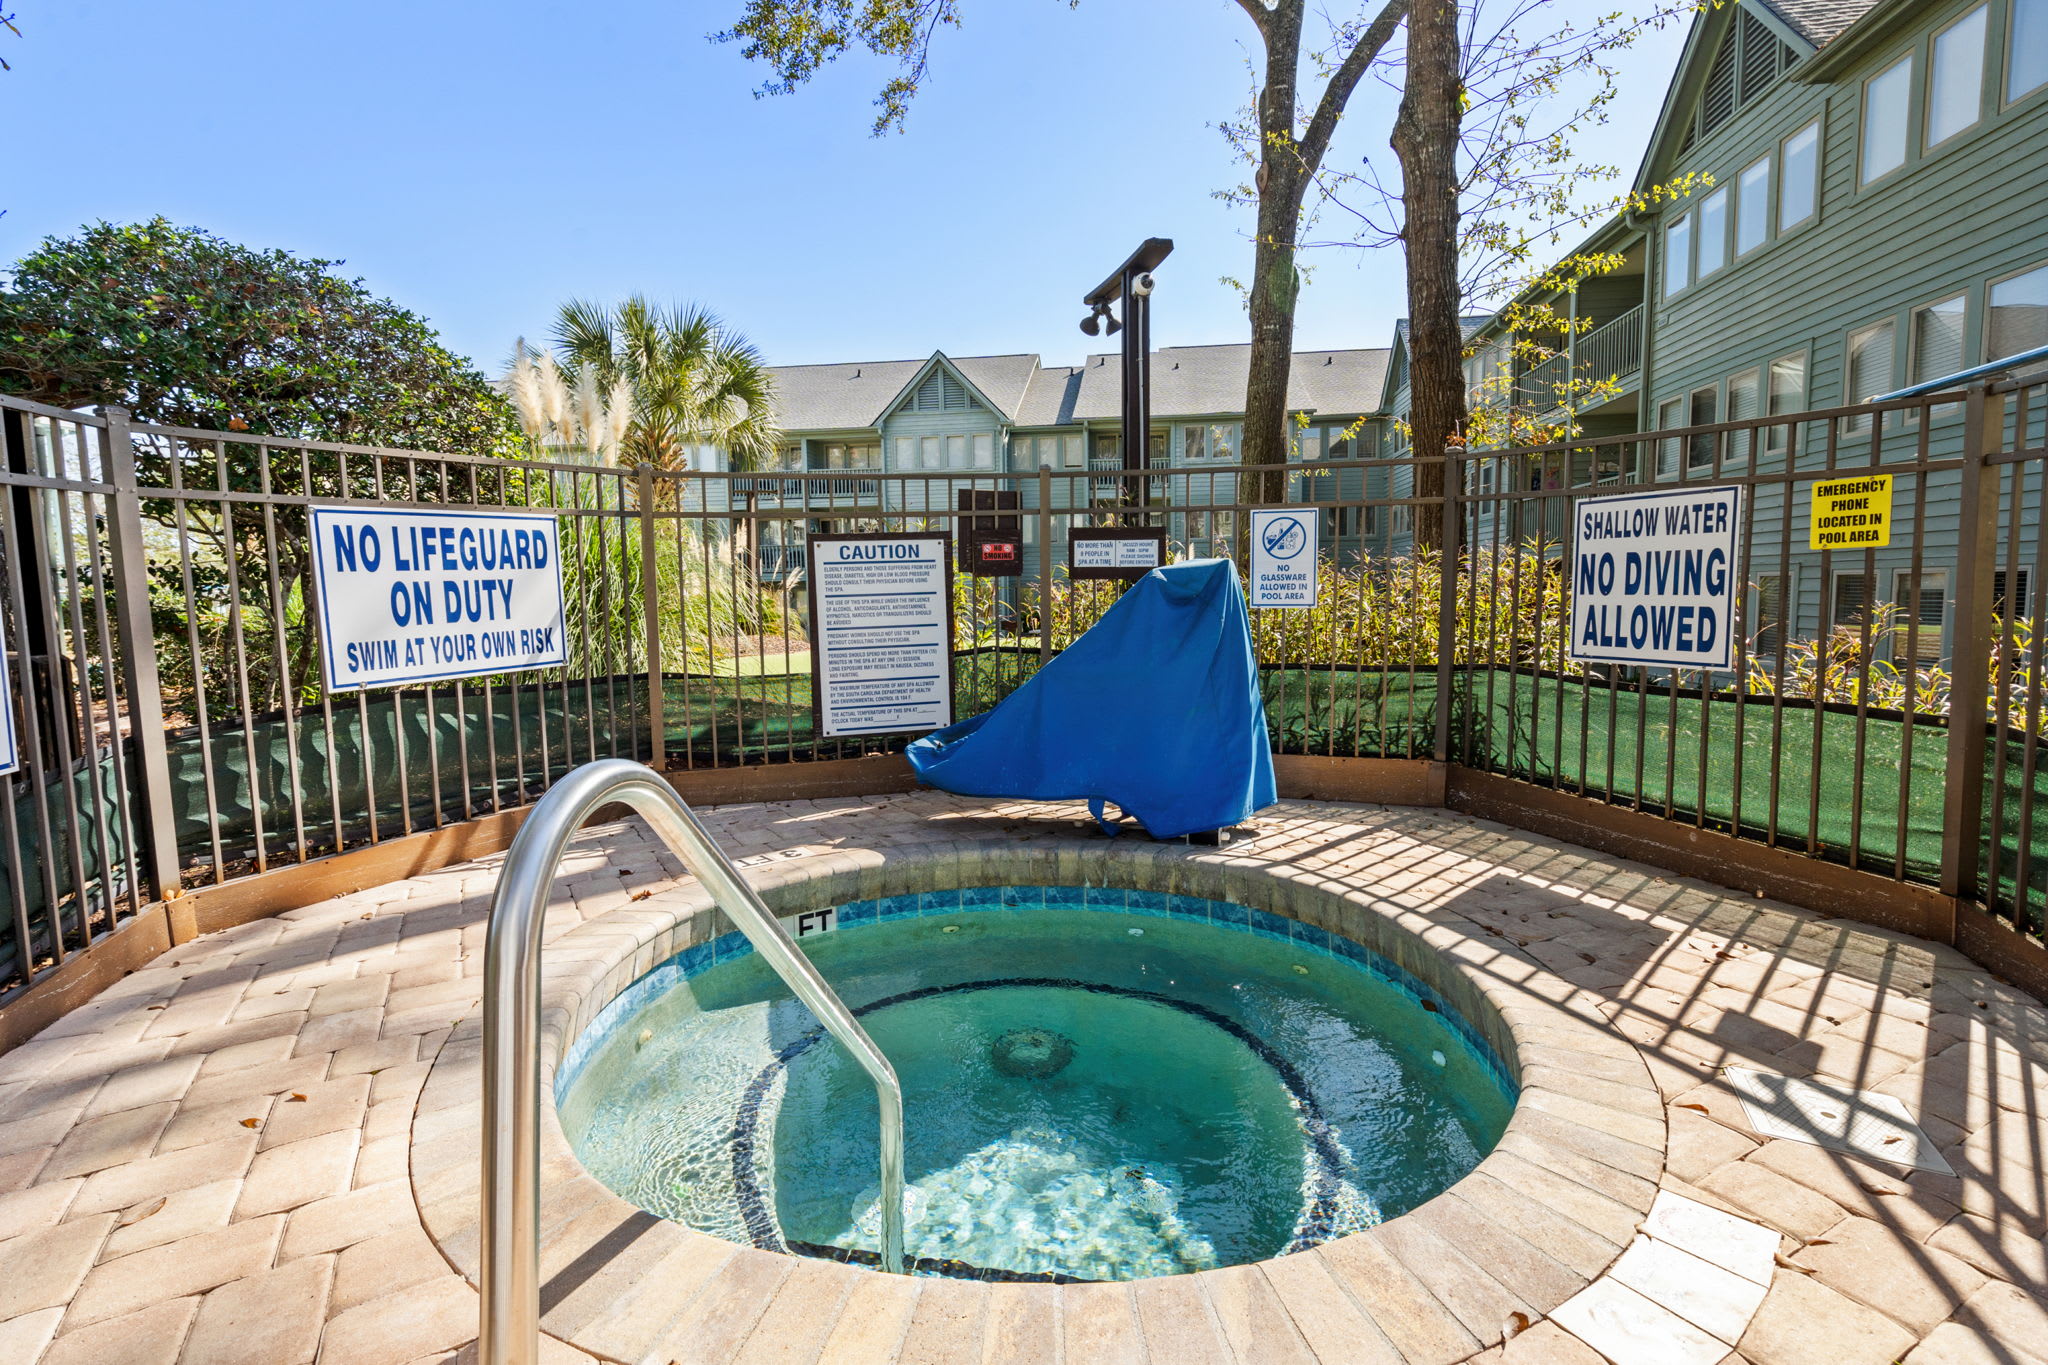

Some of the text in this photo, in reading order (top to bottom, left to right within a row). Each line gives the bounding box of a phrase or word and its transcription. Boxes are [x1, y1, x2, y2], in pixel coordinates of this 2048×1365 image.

[1817, 479, 1886, 497] EMERGENCY
[1818, 513, 1882, 528] LOCATED IN
[1831, 498, 1869, 511] PHONE
[1584, 502, 1728, 540] SHALLOW WATER
[1819, 530, 1879, 544] POOL AREA
[333, 524, 548, 572] NO LIFEGUARD
[840, 545, 919, 560] CAUTION
[1580, 548, 1725, 596] NO DIVING
[391, 579, 513, 627] ON DUTY
[1582, 605, 1717, 653] ALLOWED
[348, 627, 554, 672] SWIM AT YOUR OWN RISK
[799, 909, 832, 936] FT
